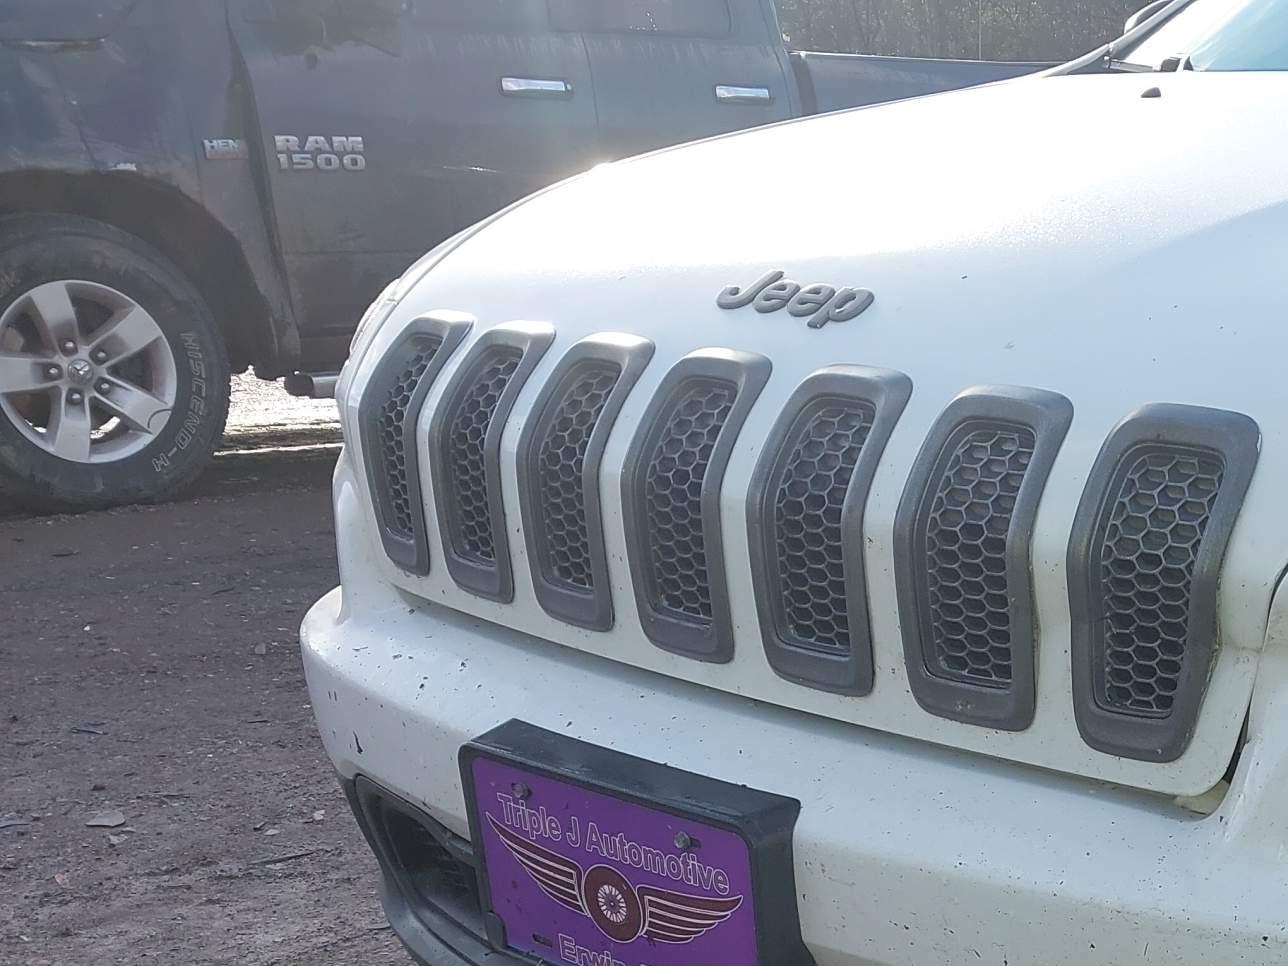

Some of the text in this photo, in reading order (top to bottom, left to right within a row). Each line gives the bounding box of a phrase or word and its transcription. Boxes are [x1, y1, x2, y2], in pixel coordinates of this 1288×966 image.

[274, 135, 365, 152] RAM
[276, 153, 367, 171] 1500
[716, 269, 875, 329] Jeep
[497, 792, 730, 895] Triple J Automotive
